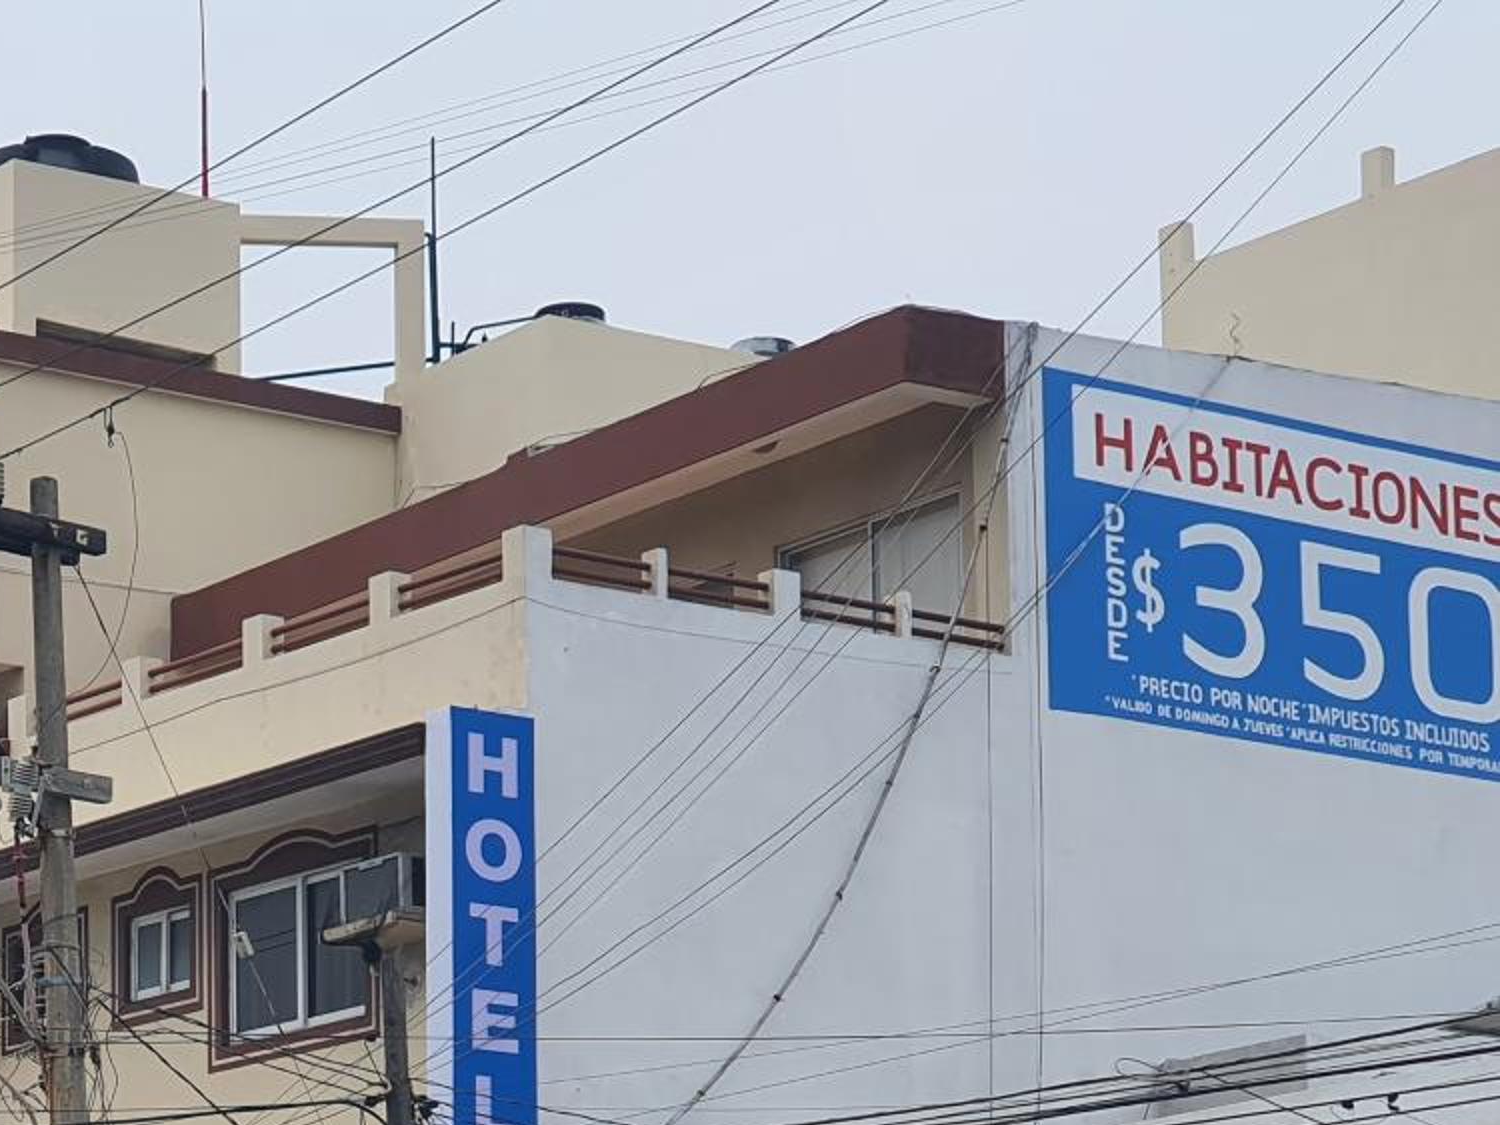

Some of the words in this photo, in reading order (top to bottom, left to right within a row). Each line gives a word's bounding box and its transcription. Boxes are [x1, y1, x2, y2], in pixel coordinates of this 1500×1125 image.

[1093, 413, 1500, 547] HABITACIONES
[1104, 502, 1130, 662] DESDE
[1157, 703, 1173, 718] DE
[1175, 707, 1230, 728] DOMINGO
[1231, 718, 1241, 731] A
[1244, 720, 1284, 737] JUEVES
[1419, 748, 1443, 765] POR
[1210, 687, 1243, 711] POR
[1247, 694, 1300, 721] NOCHE
[1404, 719, 1491, 753] INCLUIDOS
